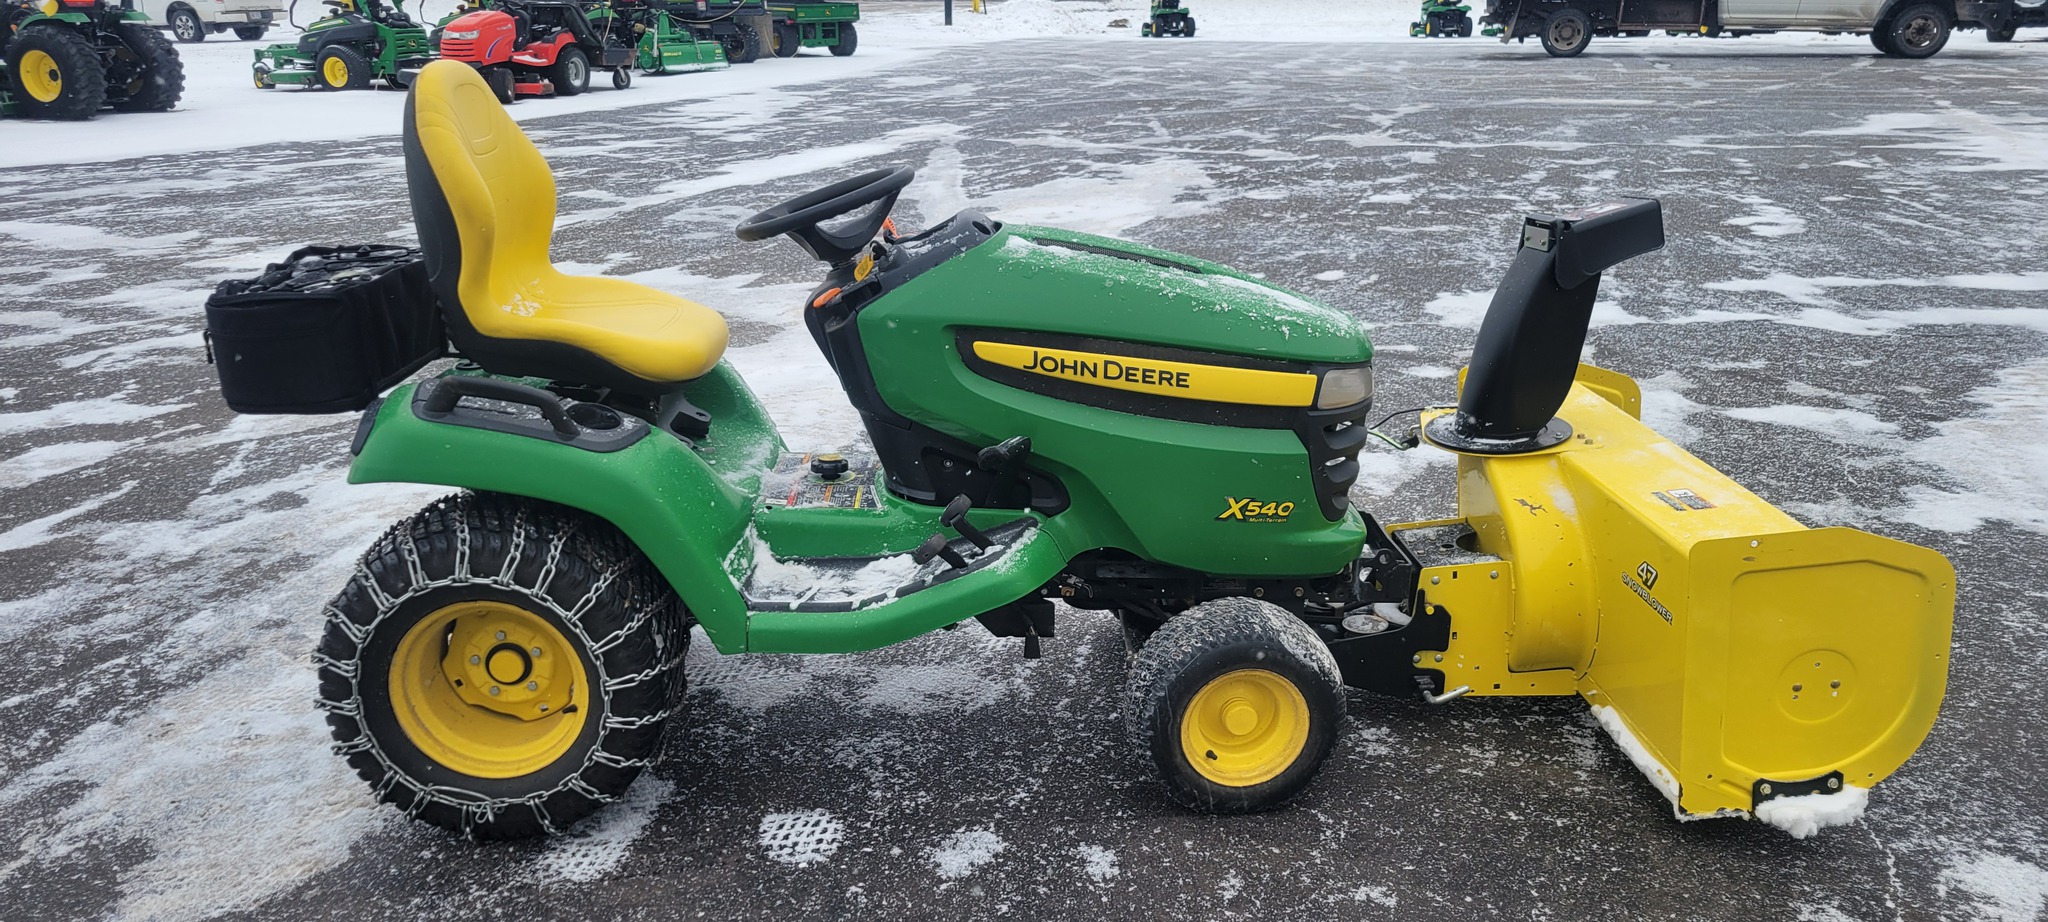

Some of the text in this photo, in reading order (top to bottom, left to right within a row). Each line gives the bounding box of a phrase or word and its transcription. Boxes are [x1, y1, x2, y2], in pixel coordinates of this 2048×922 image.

[1023, 350, 1190, 389] JOHN DEERE
[1217, 497, 1295, 520] X540
[1637, 561, 1658, 589] 47
[1621, 572, 1673, 625] SNOWBLOWER
